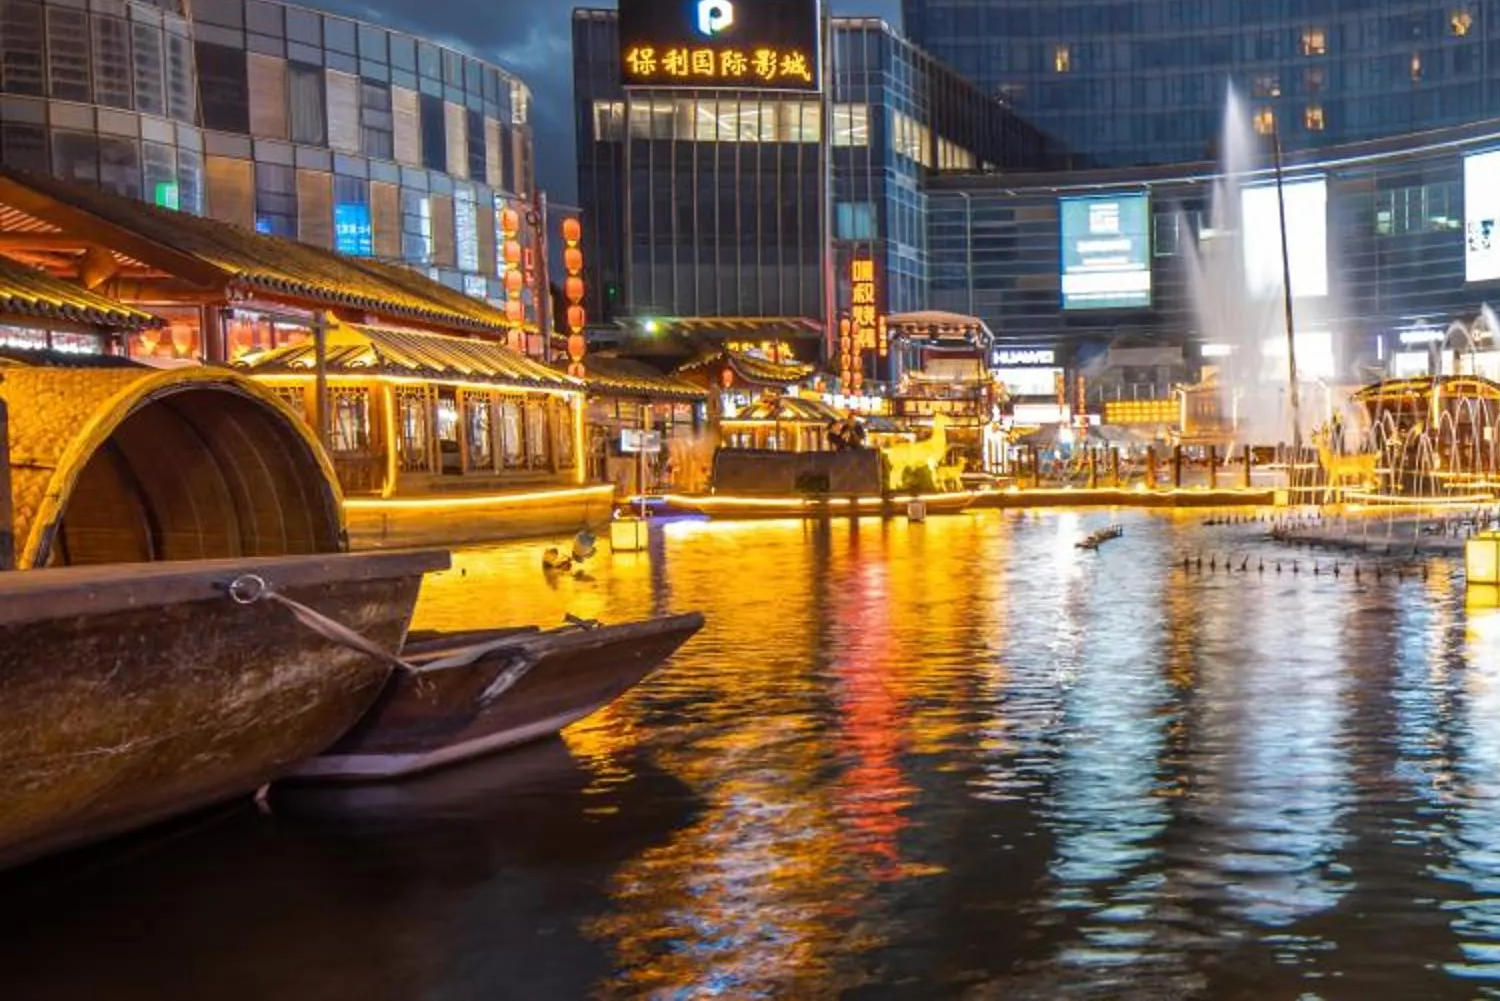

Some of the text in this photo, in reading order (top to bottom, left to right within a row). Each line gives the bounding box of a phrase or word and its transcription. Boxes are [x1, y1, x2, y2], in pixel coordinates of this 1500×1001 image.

[626, 46, 812, 82] 保利国际影城
